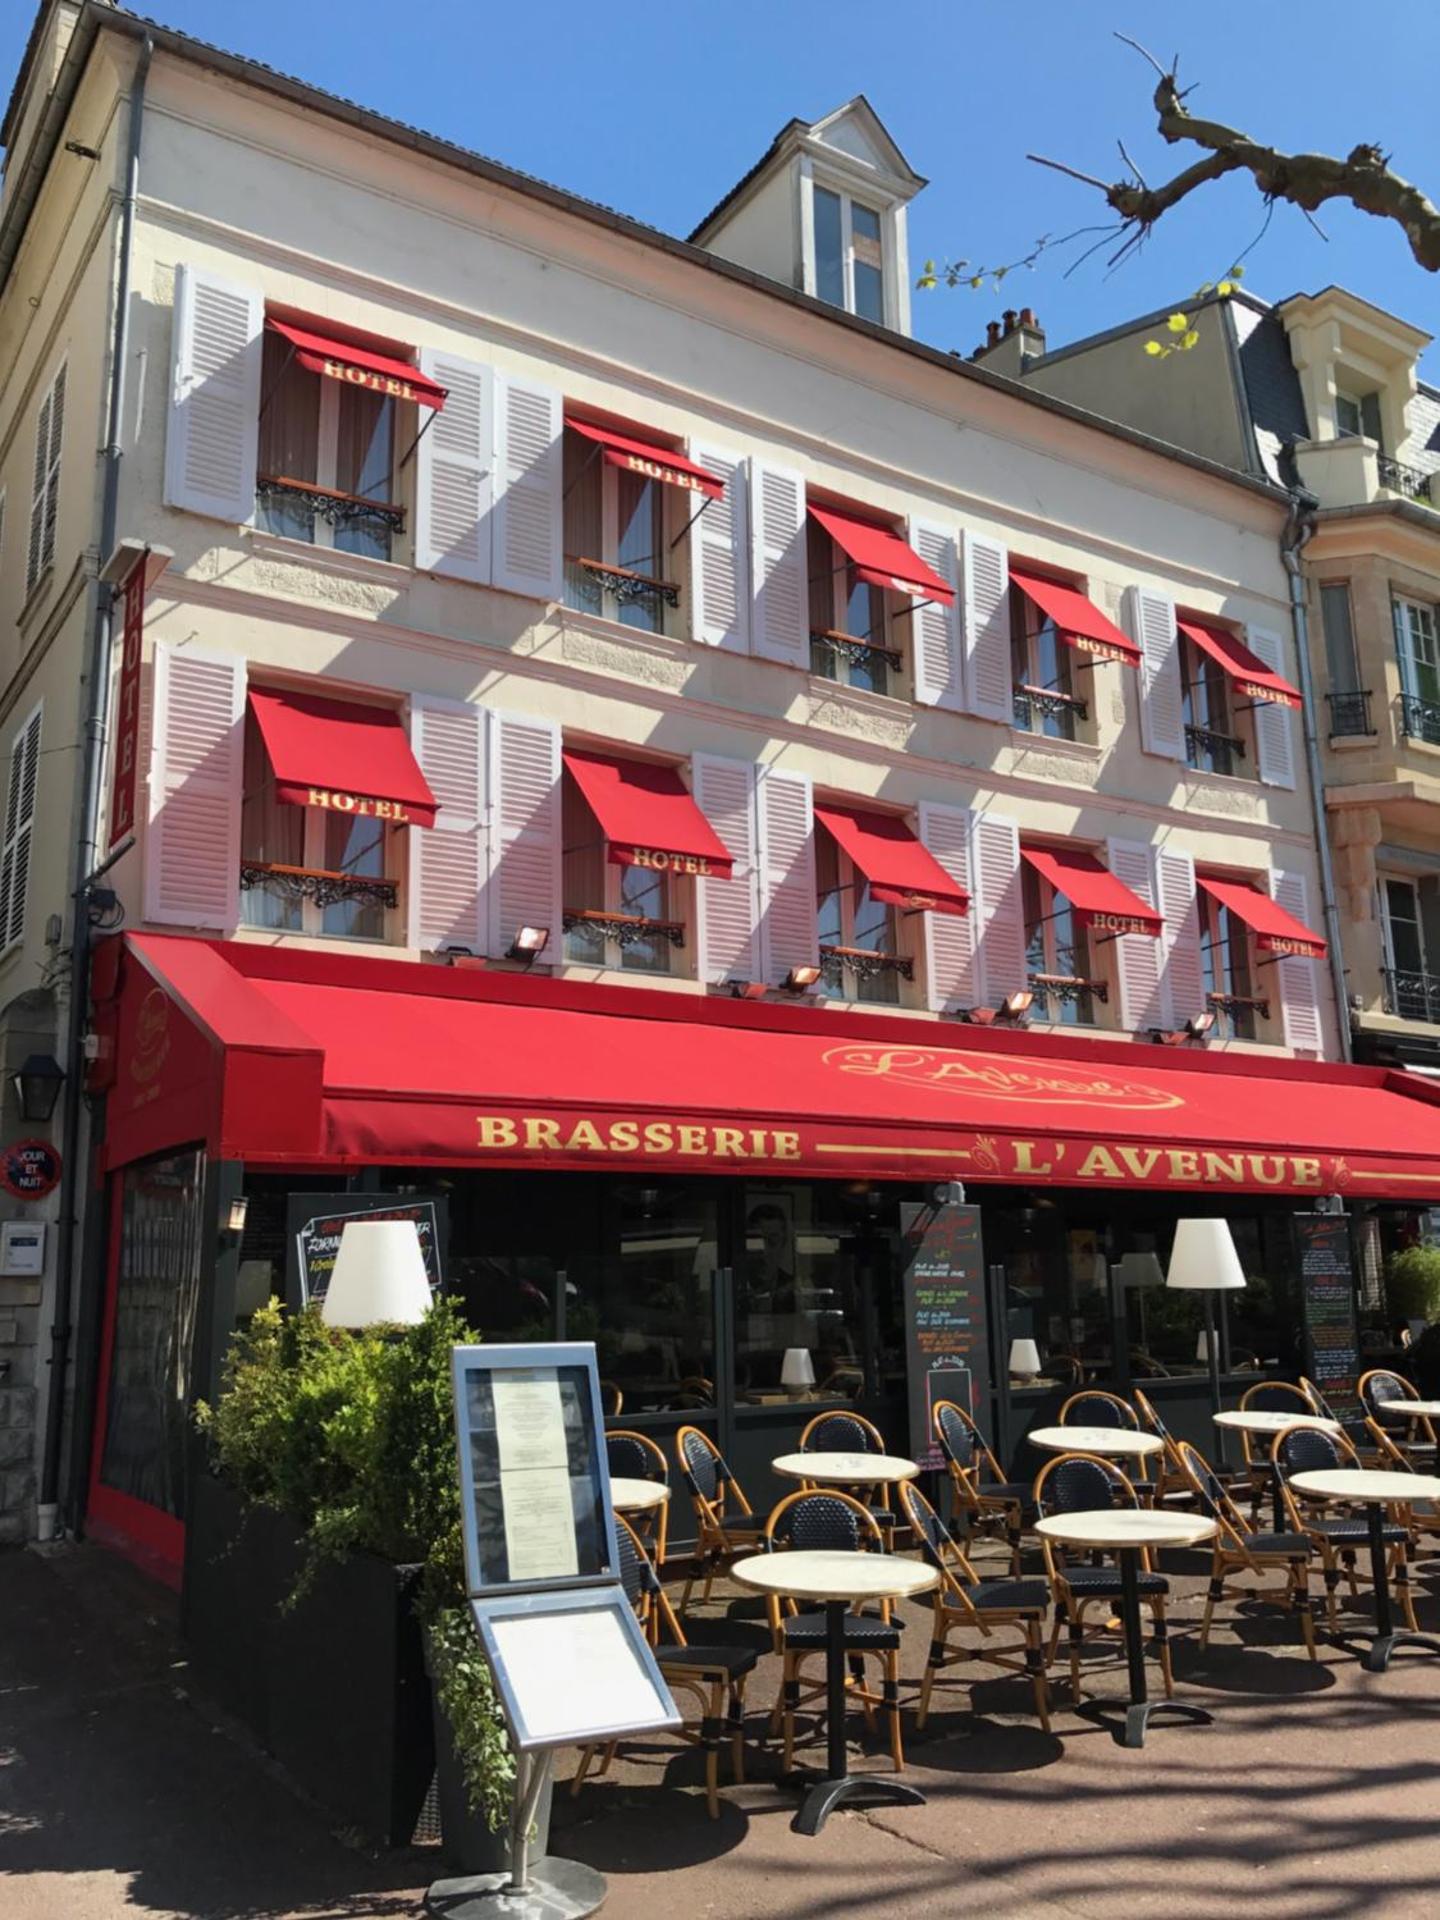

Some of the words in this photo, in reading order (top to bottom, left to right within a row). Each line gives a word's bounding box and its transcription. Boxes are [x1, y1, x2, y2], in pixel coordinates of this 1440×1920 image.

[323, 358, 417, 400] HOTEL
[628, 456, 703, 491] HOTEL
[1076, 636, 1128, 662] HOTEL
[118, 582, 141, 828] HOTEL
[1247, 683, 1291, 706] HOTEL
[307, 788, 409, 821] HOTEL
[633, 848, 712, 875] HOTEL
[1094, 914, 1149, 933] HOTEL
[1271, 937, 1315, 956] HOTEL
[477, 1117, 801, 1159] BRASSERIE
[20, 1177, 41, 1187] NUIT
[25, 1164, 38, 1175] ET
